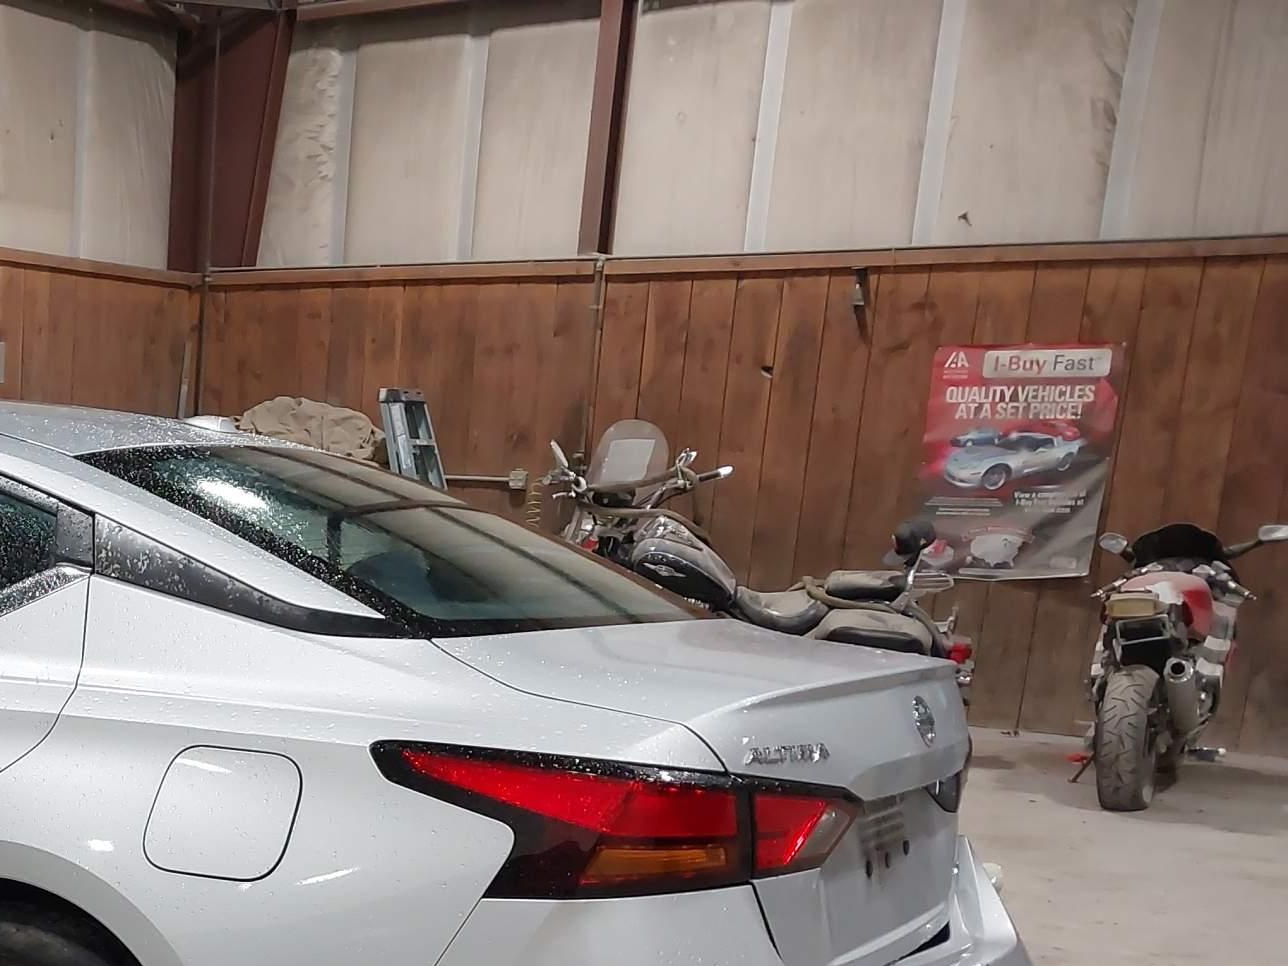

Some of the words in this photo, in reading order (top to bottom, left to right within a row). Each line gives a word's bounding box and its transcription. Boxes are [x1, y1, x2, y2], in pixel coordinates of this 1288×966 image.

[994, 355, 1047, 375] I-Buy
[1052, 354, 1095, 371] Fast
[945, 386, 1015, 403] QUALITY
[1017, 385, 1096, 403] VEHICLES
[955, 402, 978, 419] AT
[978, 403, 992, 419] A
[995, 402, 1028, 419] SET
[1029, 401, 1083, 419] PRICE!
